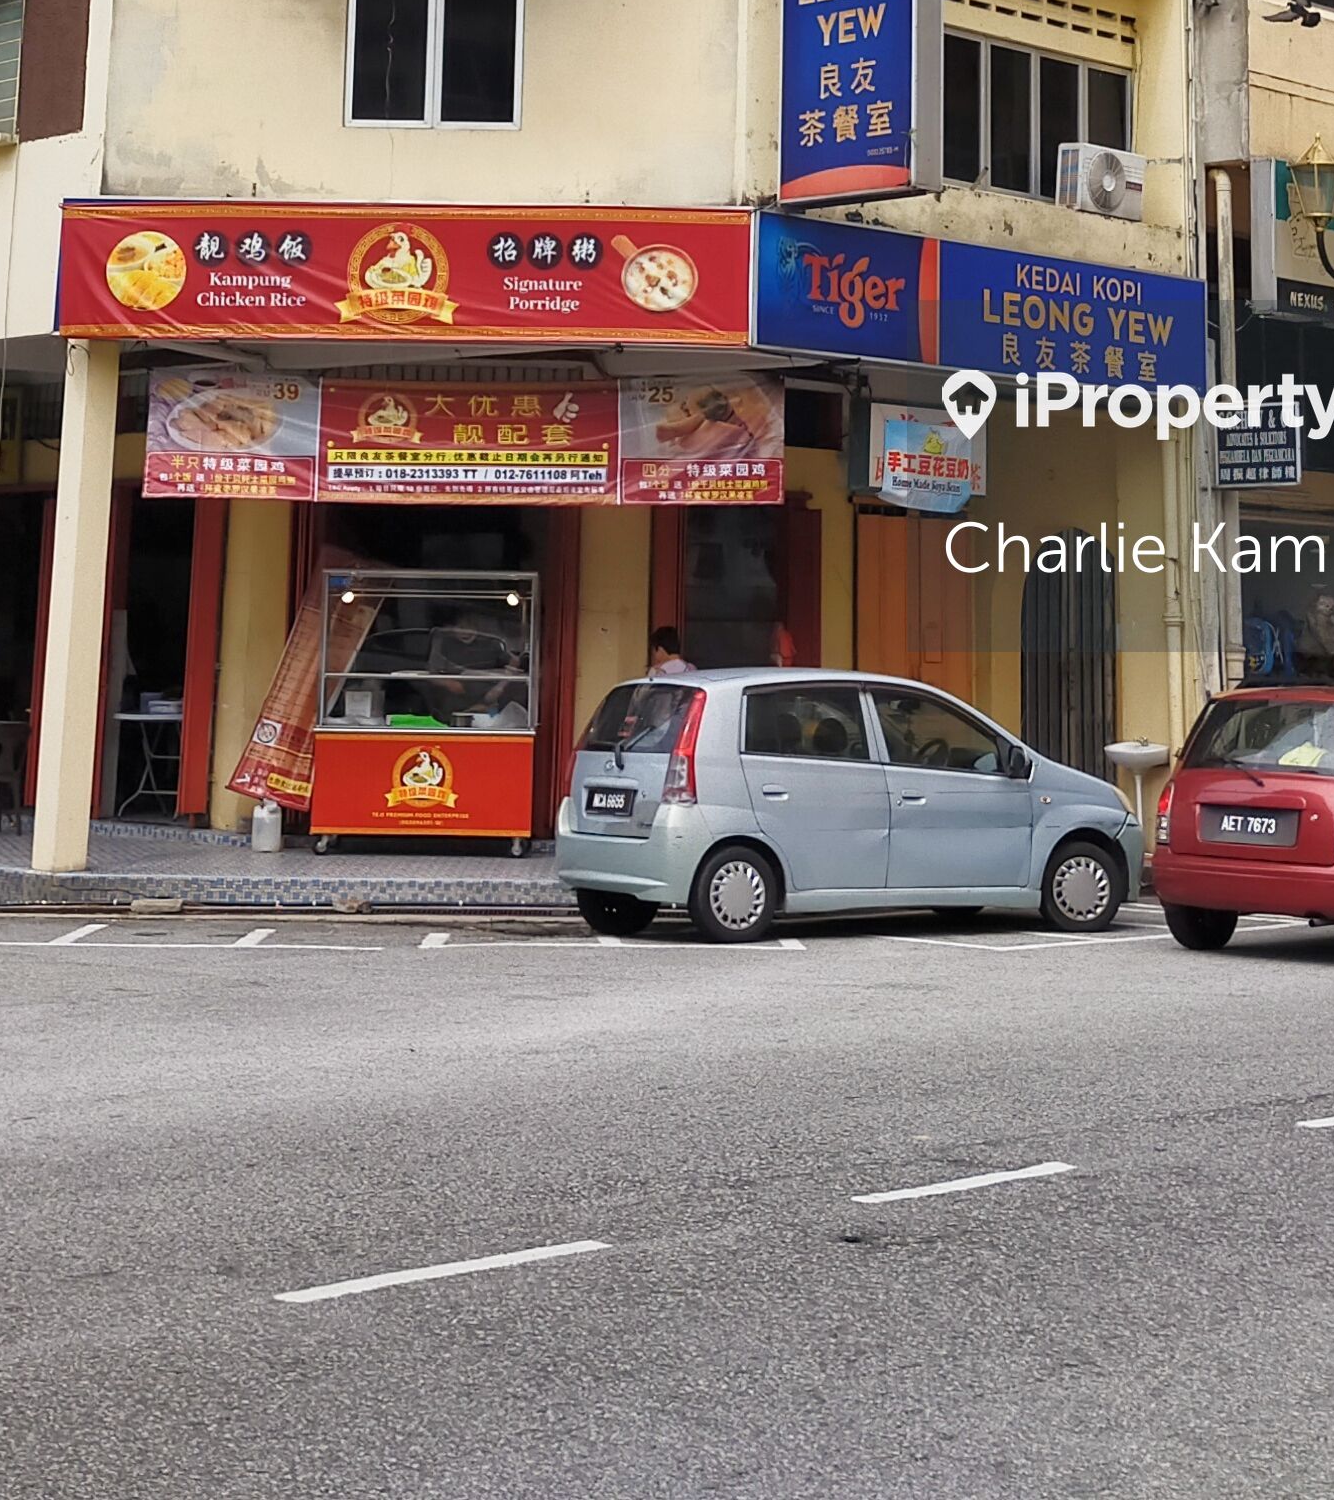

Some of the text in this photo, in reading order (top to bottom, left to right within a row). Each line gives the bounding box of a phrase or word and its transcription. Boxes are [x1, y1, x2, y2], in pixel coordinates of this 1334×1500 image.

[817, 3, 887, 46] YEW
[819, 57, 877, 100] 良友
[798, 100, 893, 147] 茶餐室
[209, 272, 292, 290] Kampung
[503, 276, 583, 292] Signature
[802, 253, 906, 329] Tiger
[1016, 263, 1142, 305] KEDAI KOPI
[196, 292, 306, 307] Chicken Rice
[509, 295, 580, 313] Porridge
[983, 288, 1174, 347] LEONG YEW
[1002, 332, 1157, 382] 良友茶餐室
[273, 383, 299, 400] 39
[648, 386, 673, 403] 25
[424, 394, 542, 418] 大优惠
[385, 468, 459, 480] 018-2313393
[494, 468, 567, 480] 012-7611108
[1221, 815, 1276, 834] AET 7673
